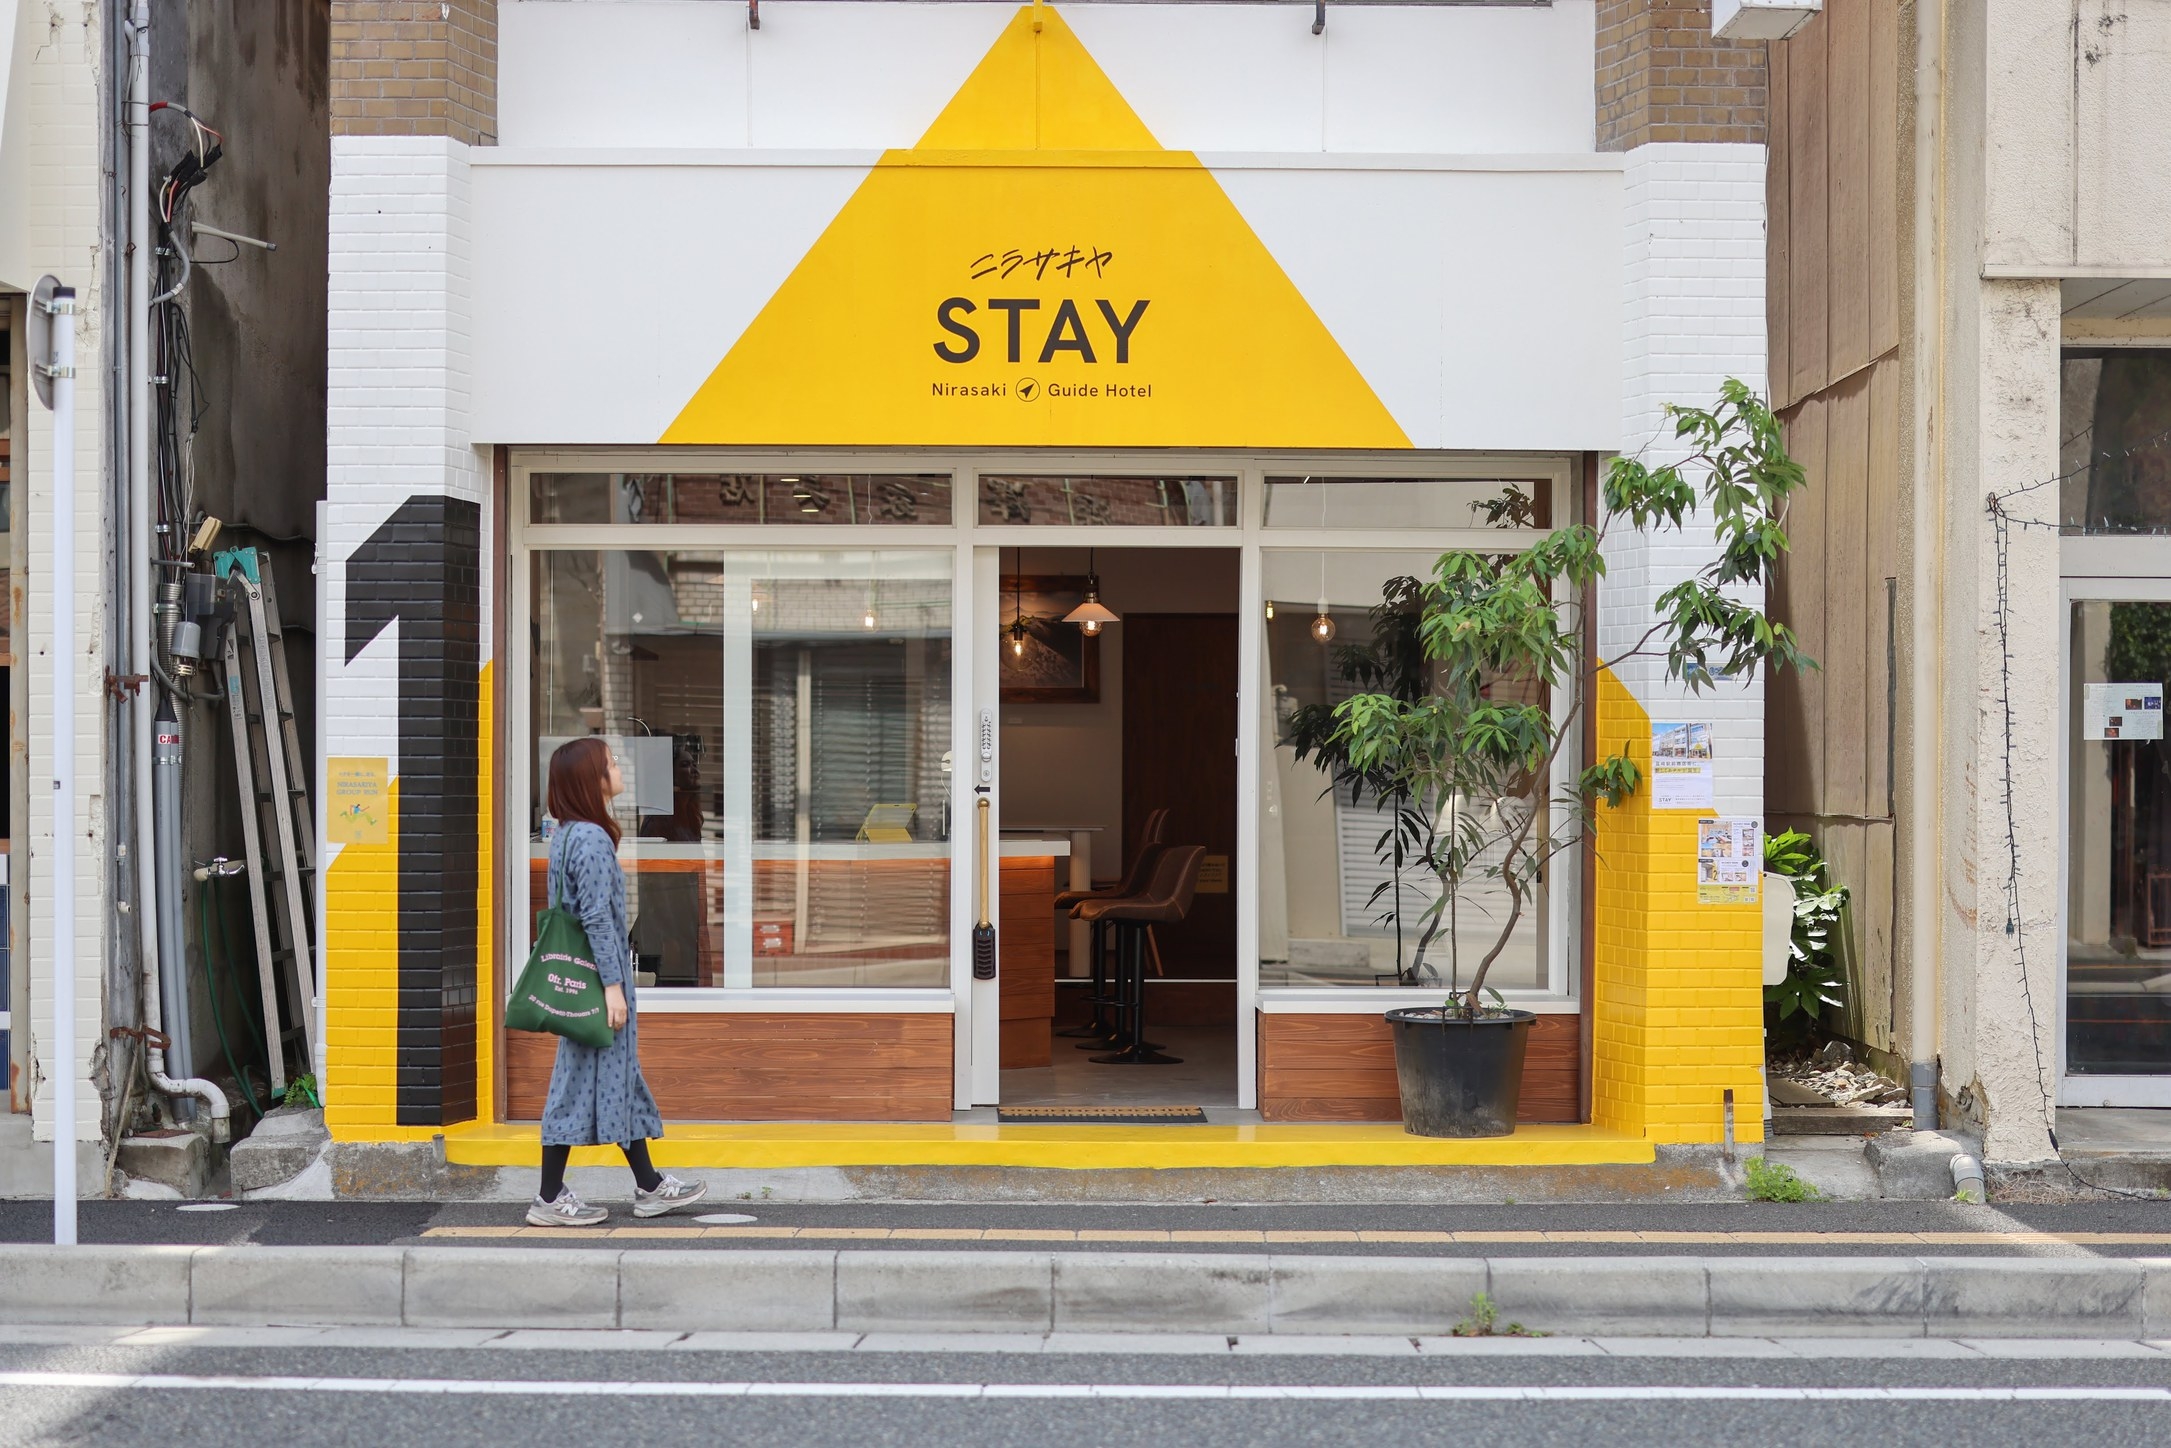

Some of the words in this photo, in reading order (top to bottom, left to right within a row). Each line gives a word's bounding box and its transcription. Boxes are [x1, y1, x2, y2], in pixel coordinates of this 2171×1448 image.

[970, 245, 1113, 281] ニラサキヤ
[932, 296, 1151, 363] STAY
[932, 382, 1007, 397] Nirasaki
[1048, 383, 1099, 397] Guide
[1105, 383, 1152, 397] Hotel
[541, 954, 571, 962] Librairie
[565, 978, 586, 989] Paris
[560, 1203, 578, 1216] N
